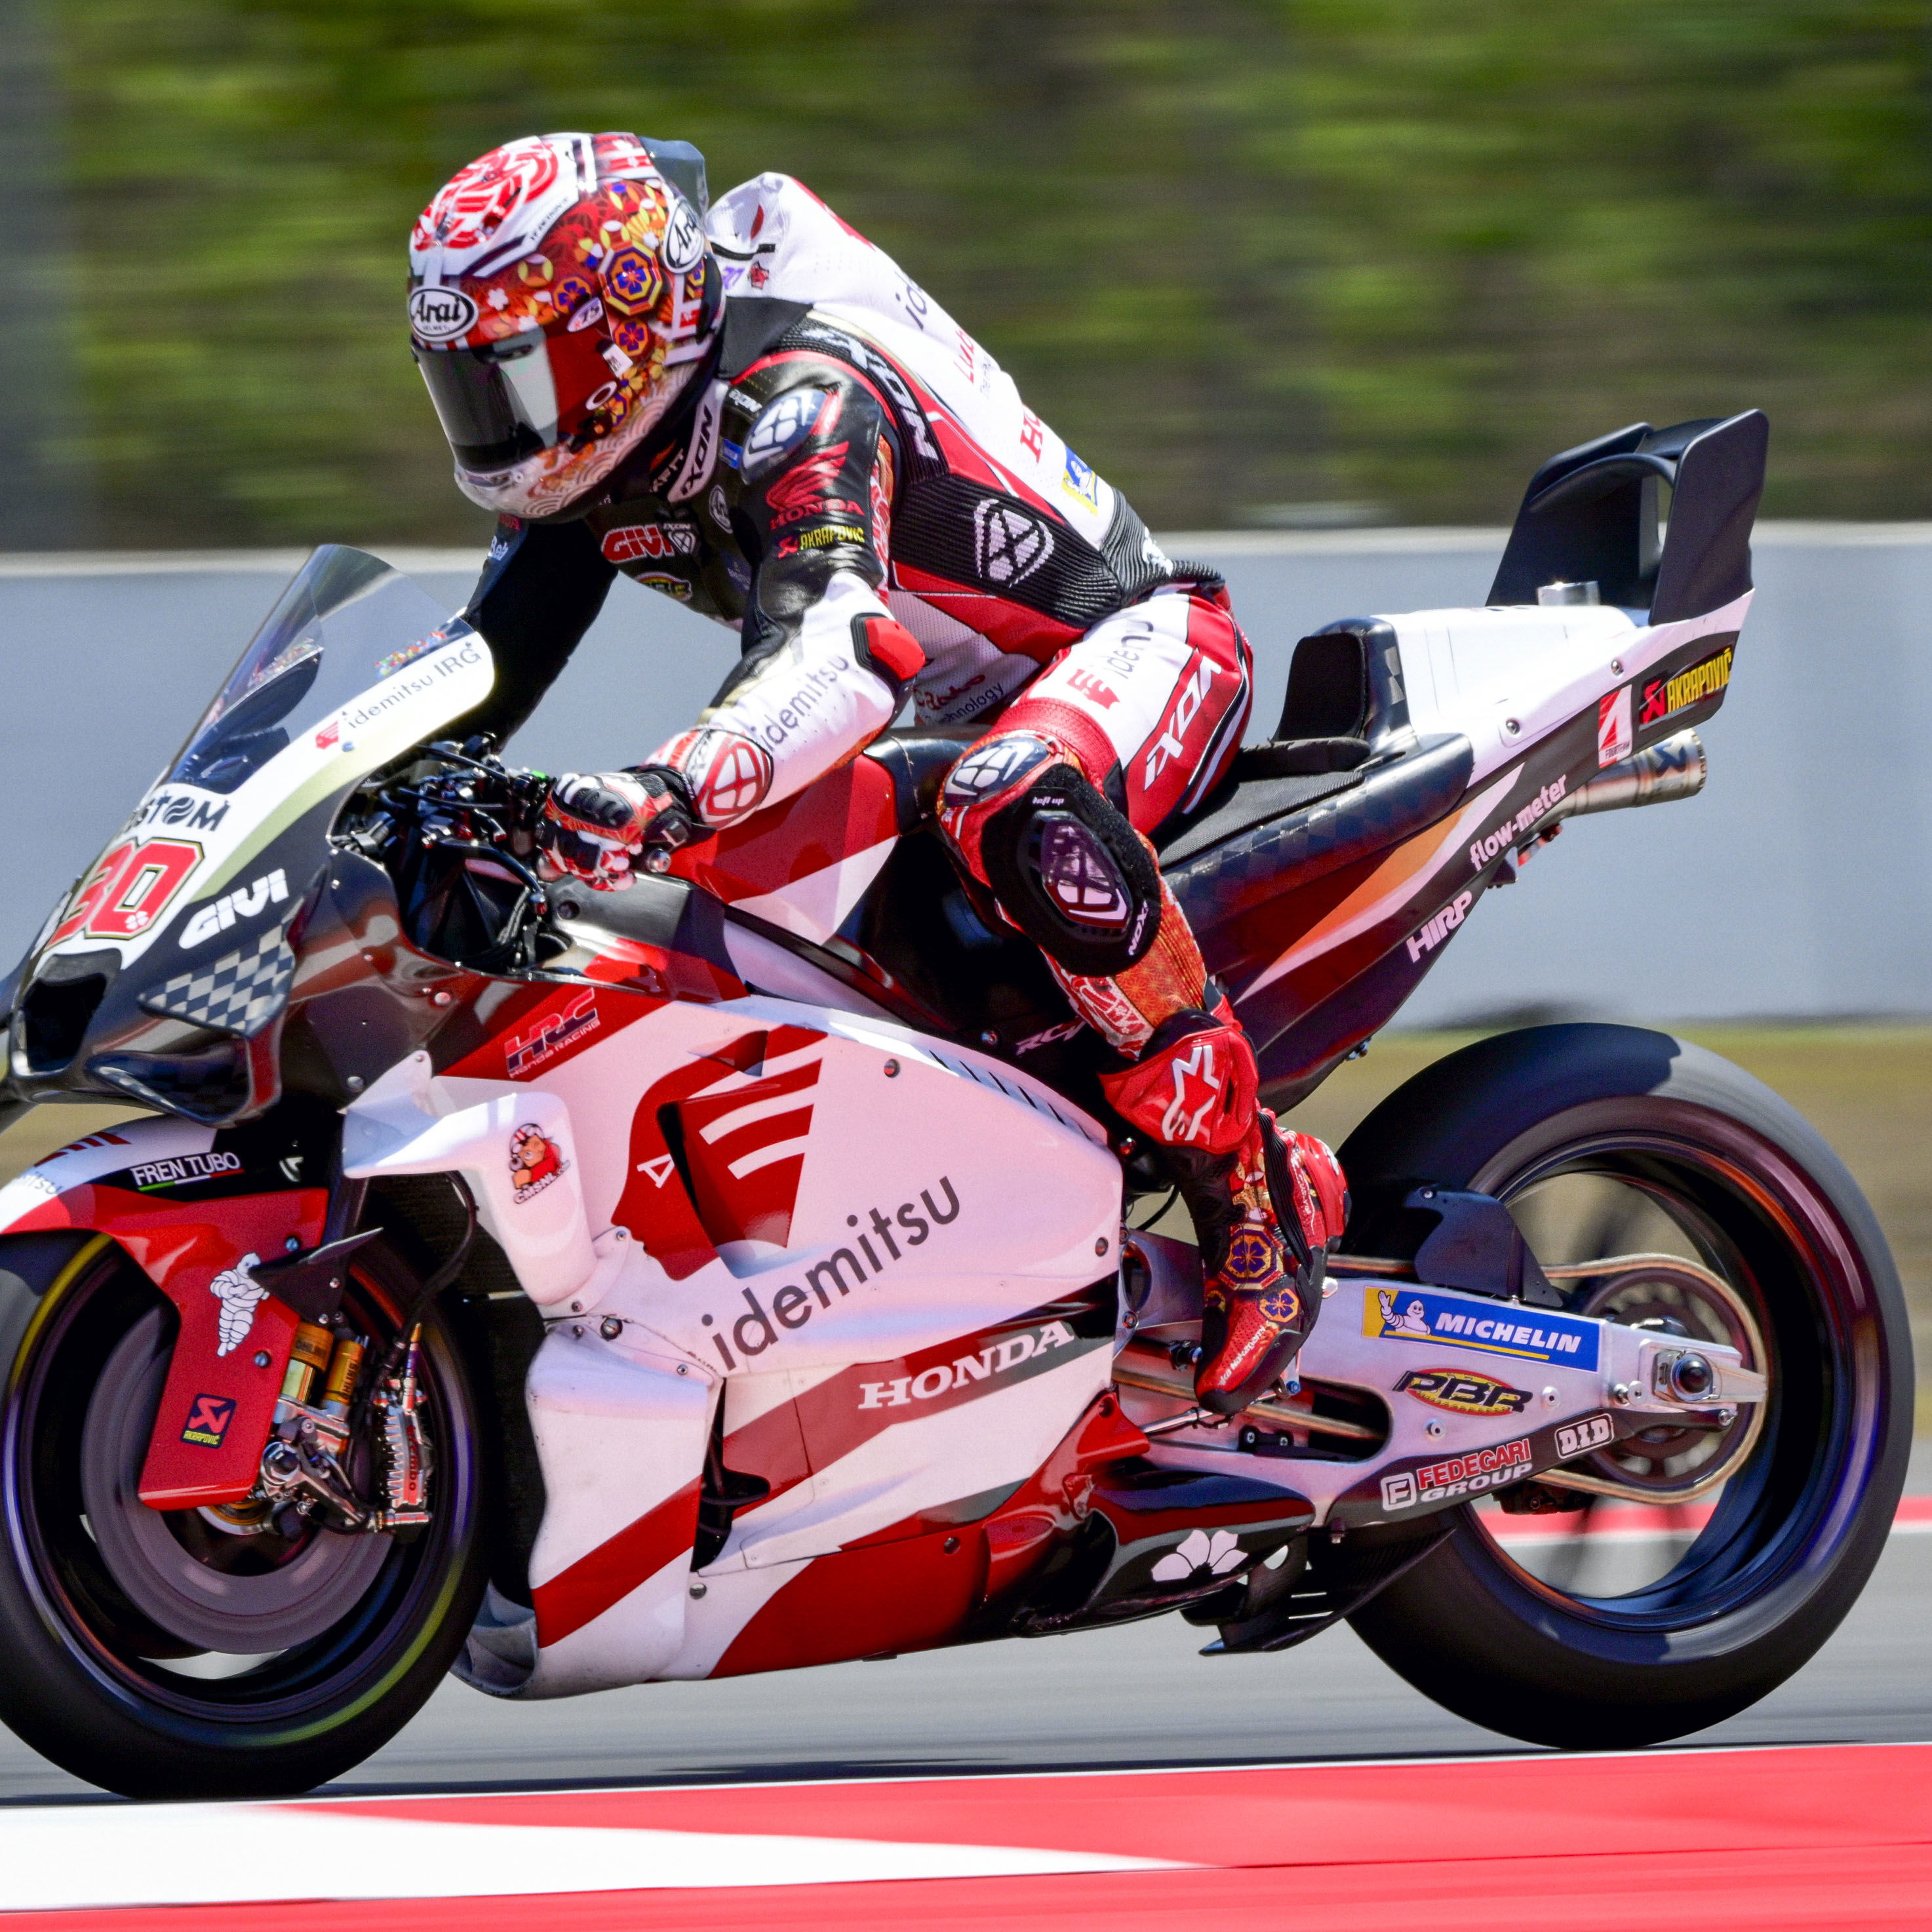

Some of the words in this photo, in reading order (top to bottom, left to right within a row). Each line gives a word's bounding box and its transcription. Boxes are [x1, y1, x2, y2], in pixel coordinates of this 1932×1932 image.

[412, 294, 461, 323] Arai
[680, 404, 713, 495] IXON
[601, 524, 675, 563] GIVI
[770, 498, 865, 530] HONDA
[347, 674, 433, 728] idemitsu
[434, 648, 482, 677] IRG
[750, 656, 849, 752] idemitsu
[1144, 656, 1222, 791] IXON
[1470, 774, 1568, 871] flow-meter
[178, 868, 290, 949] GIVI
[1128, 899, 1149, 956] IXON
[504, 987, 598, 1072] HRC
[554, 1018, 601, 1052] RACING
[130, 1159, 187, 1187] FREN
[184, 1152, 241, 1175] TUBO
[702, 1176, 960, 1370] idemitsu
[1434, 1313, 1582, 1353] MICHELIN
[858, 1320, 1074, 1410] HONDA
[1390, 1370, 1533, 1413] PBR
[406, 1425, 420, 1491] brembo
[1416, 1438, 1532, 1490] FEDEGARI
[1420, 1463, 1533, 1503] GROUP
